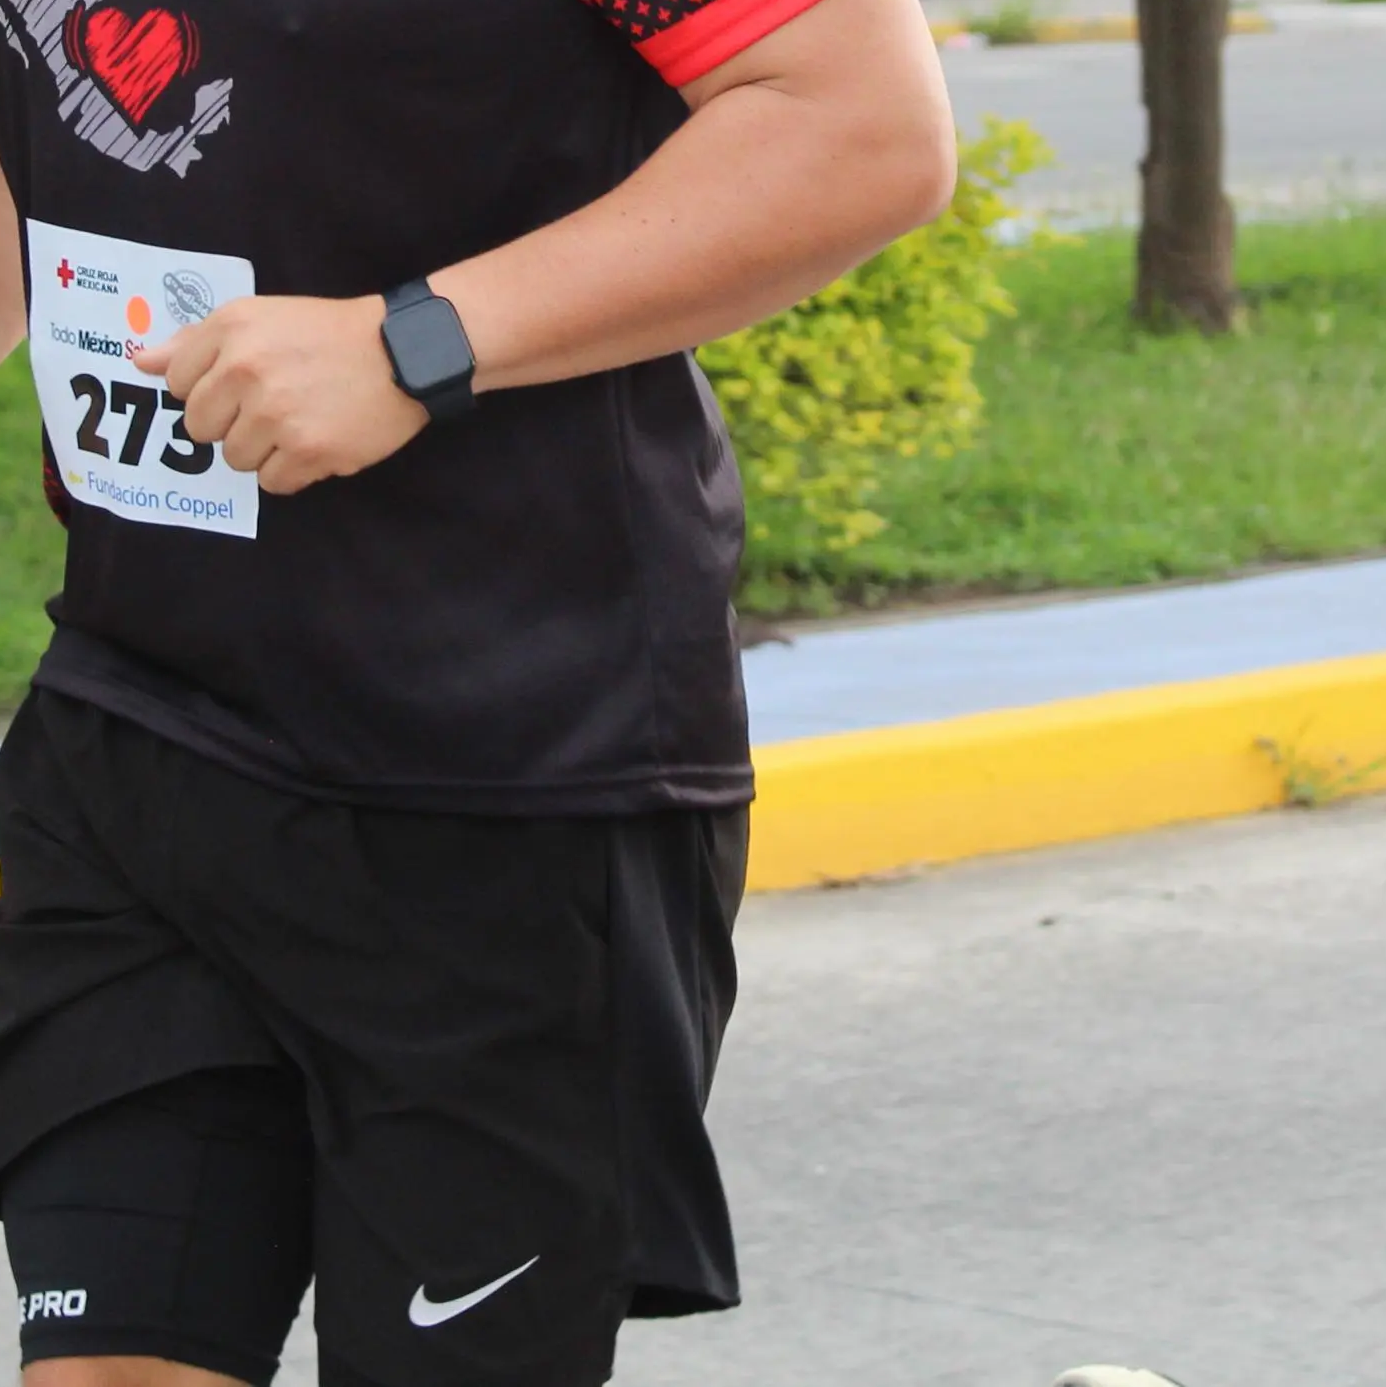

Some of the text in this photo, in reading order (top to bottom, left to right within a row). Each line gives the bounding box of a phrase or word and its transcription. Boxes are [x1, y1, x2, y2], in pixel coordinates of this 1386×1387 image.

[76, 265, 119, 283] CRUZ ROJA
[76, 277, 119, 295] MEXICANA
[50, 321, 77, 345] Todo
[78, 329, 123, 357] México
[70, 373, 215, 475] 273
[88, 471, 234, 520] Fundación Coppel
[27, 1288, 87, 1320] PRO
